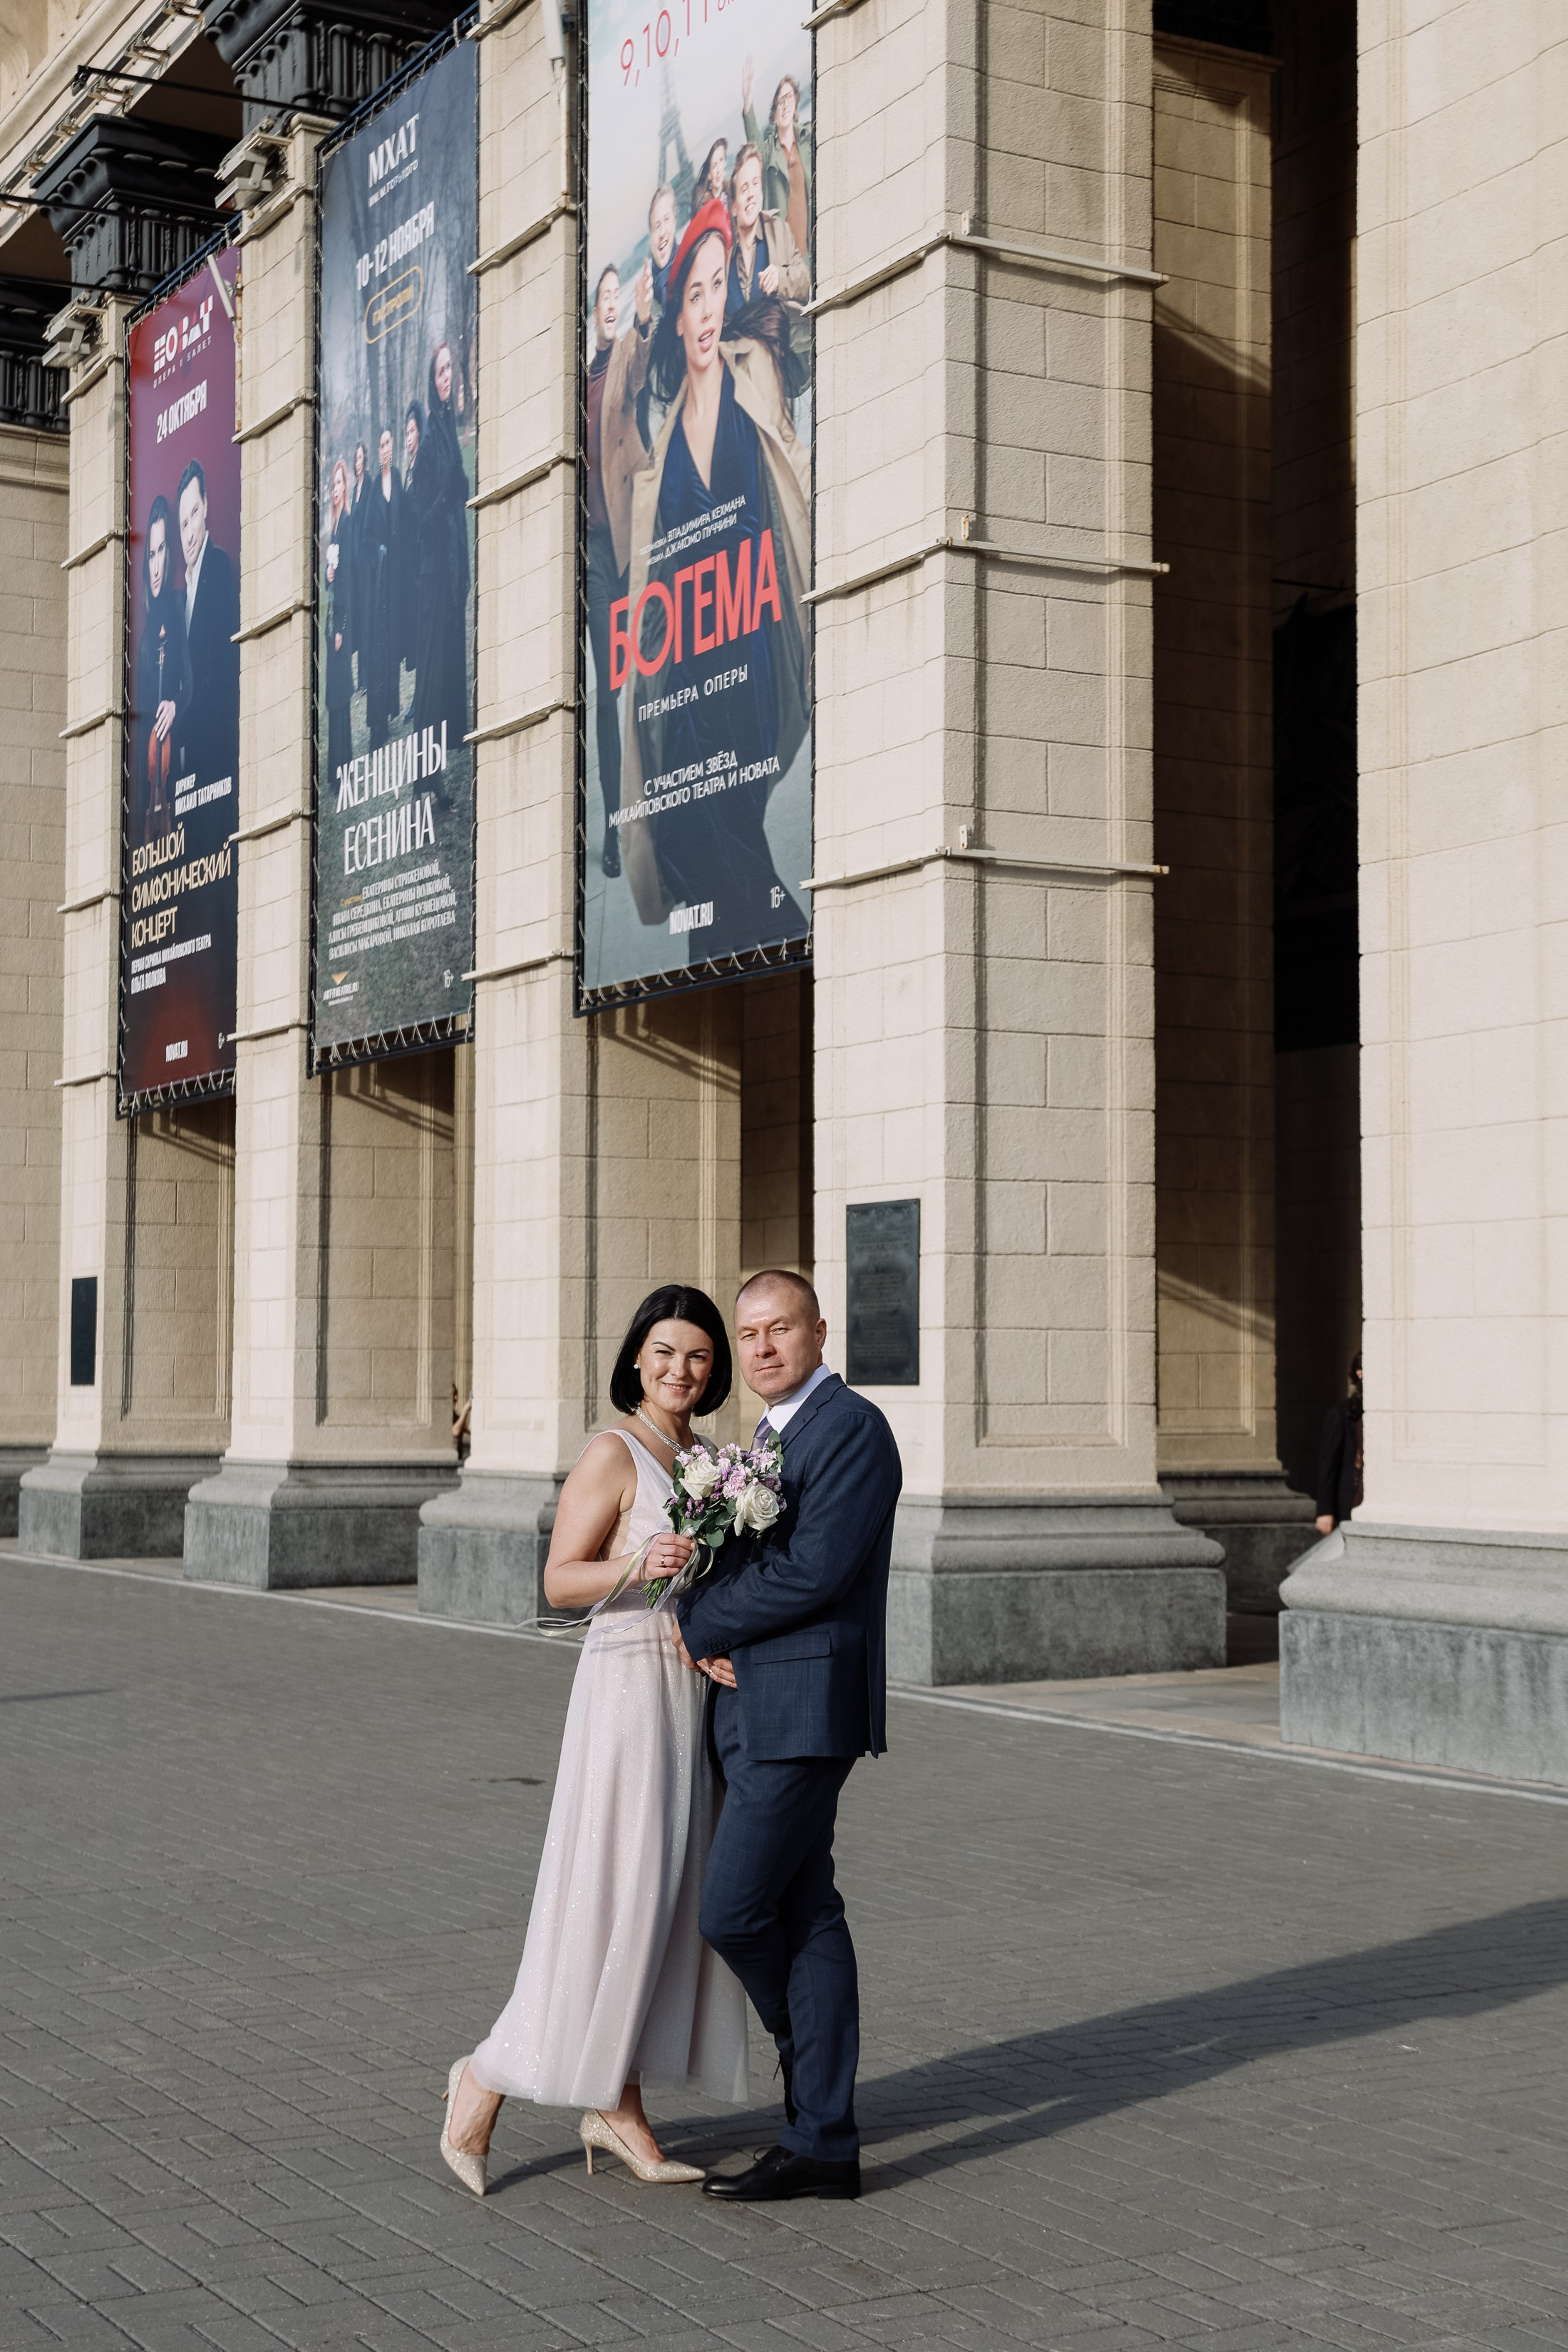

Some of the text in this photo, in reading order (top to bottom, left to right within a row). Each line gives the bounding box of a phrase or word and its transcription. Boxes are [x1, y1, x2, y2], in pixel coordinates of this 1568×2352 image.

[368, 113, 420, 188] МХАТ
[356, 200, 435, 292] 10-12 НОЯБРЯ
[372, 284, 414, 326] ГАСТРОЛИ
[153, 336, 212, 389] ОПЕРА БАЛЕТ
[156, 379, 207, 444] 24 ОКТЯБРЯ
[664, 530, 702, 559] ДЖАКОМО
[701, 512, 738, 540] ПУЧЧИНИ
[666, 512, 711, 543] ВЛАДИМИРА
[711, 494, 747, 521] КЕХМАНА
[609, 528, 783, 691] БОГЕМА
[638, 664, 748, 723] ПРЕМЬЕРА ОПЕРЫ
[336, 719, 448, 814] ЖЕНЩИНЫ
[644, 750, 738, 797] С УЧАСТИЕМ ЗВЁЗД
[197, 775, 232, 808] ТАТАРНИКОВ
[608, 755, 781, 829] МИХАЙЛОВСКОГО ТЕАТРА И НОВАТА
[133, 821, 185, 877] БОЛЬШОЙ
[344, 795, 435, 876] ЕСЕНИНА
[132, 841, 231, 913] СИМФОНИЧЕСКИЙ
[362, 877, 394, 900] ЕКАТЕРИНЫ
[383, 887, 416, 907] ЕКАТЕРИНЫ
[770, 885, 786, 909] 16+
[132, 905, 178, 949] КОНЦЕРТ
[420, 909, 456, 933] КОРОТАЕВА
[669, 900, 713, 936] NOVAT.RU
[443, 969, 455, 989] 16+
